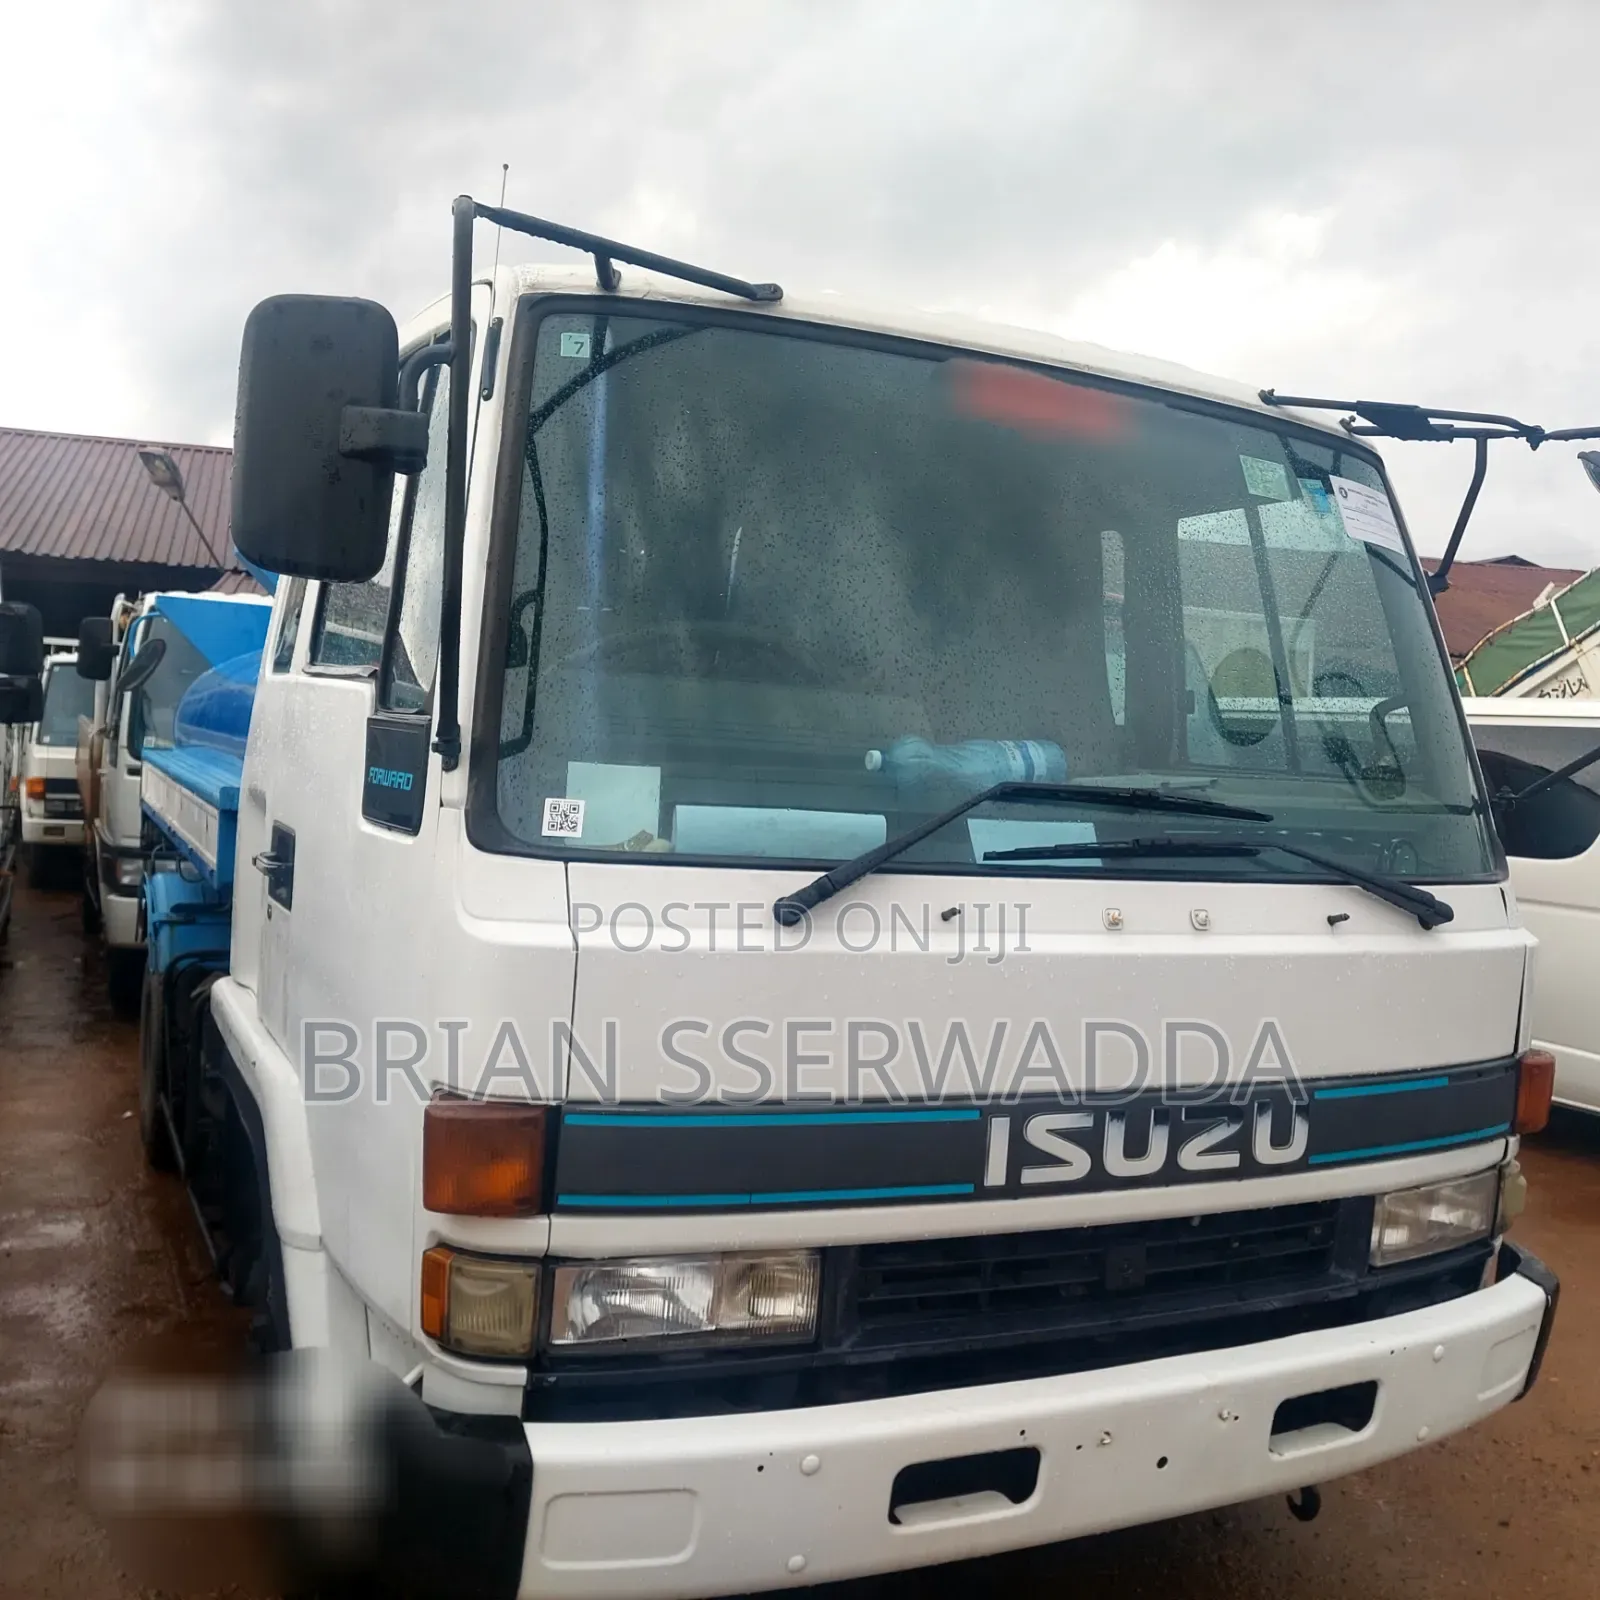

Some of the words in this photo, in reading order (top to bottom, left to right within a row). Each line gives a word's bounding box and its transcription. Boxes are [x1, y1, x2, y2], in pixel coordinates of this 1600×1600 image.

[574, 341, 585, 354] 7
[369, 767, 413, 790] FORWARD
[984, 1100, 1309, 1187] ISUZU
